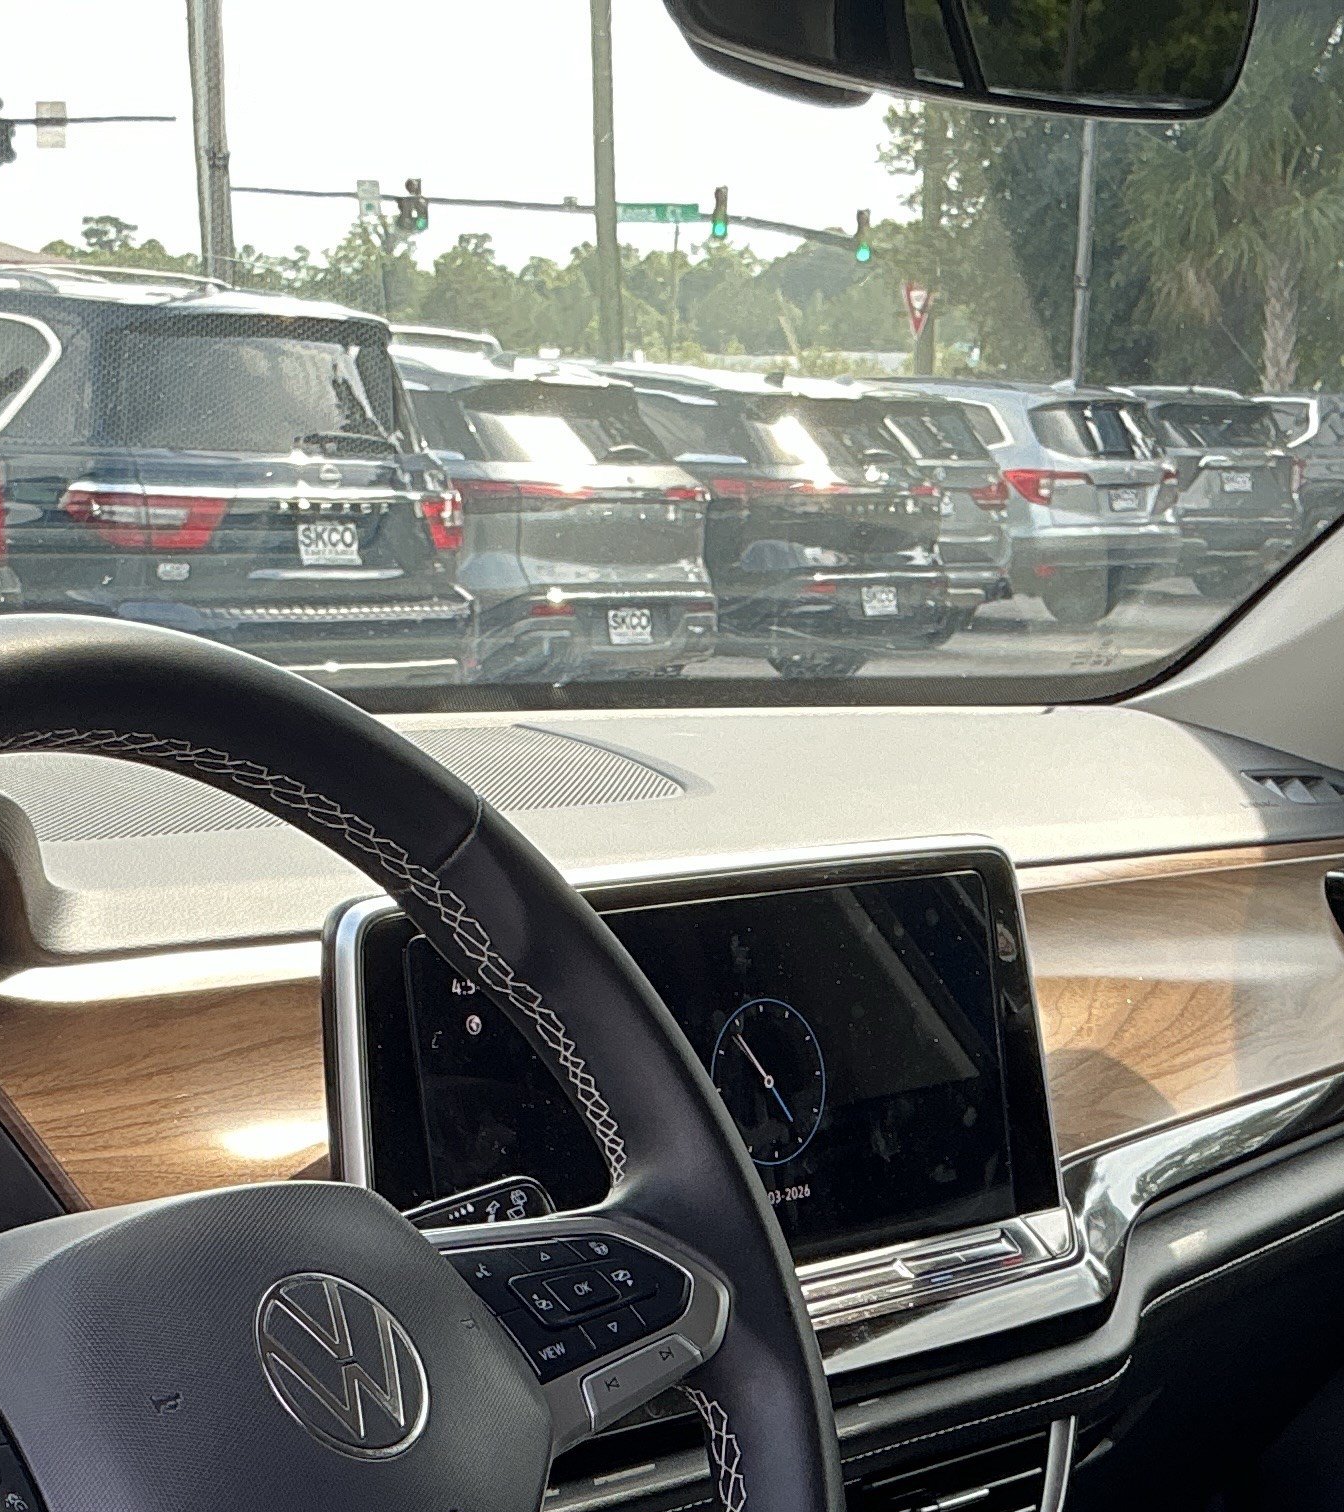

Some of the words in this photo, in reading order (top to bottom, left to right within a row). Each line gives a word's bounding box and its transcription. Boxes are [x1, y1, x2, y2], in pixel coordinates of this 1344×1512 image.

[300, 526, 355, 548] SKCO
[451, 977, 481, 996] 4:5
[573, 1280, 594, 1297] OK
[538, 1342, 566, 1361] VIEW
